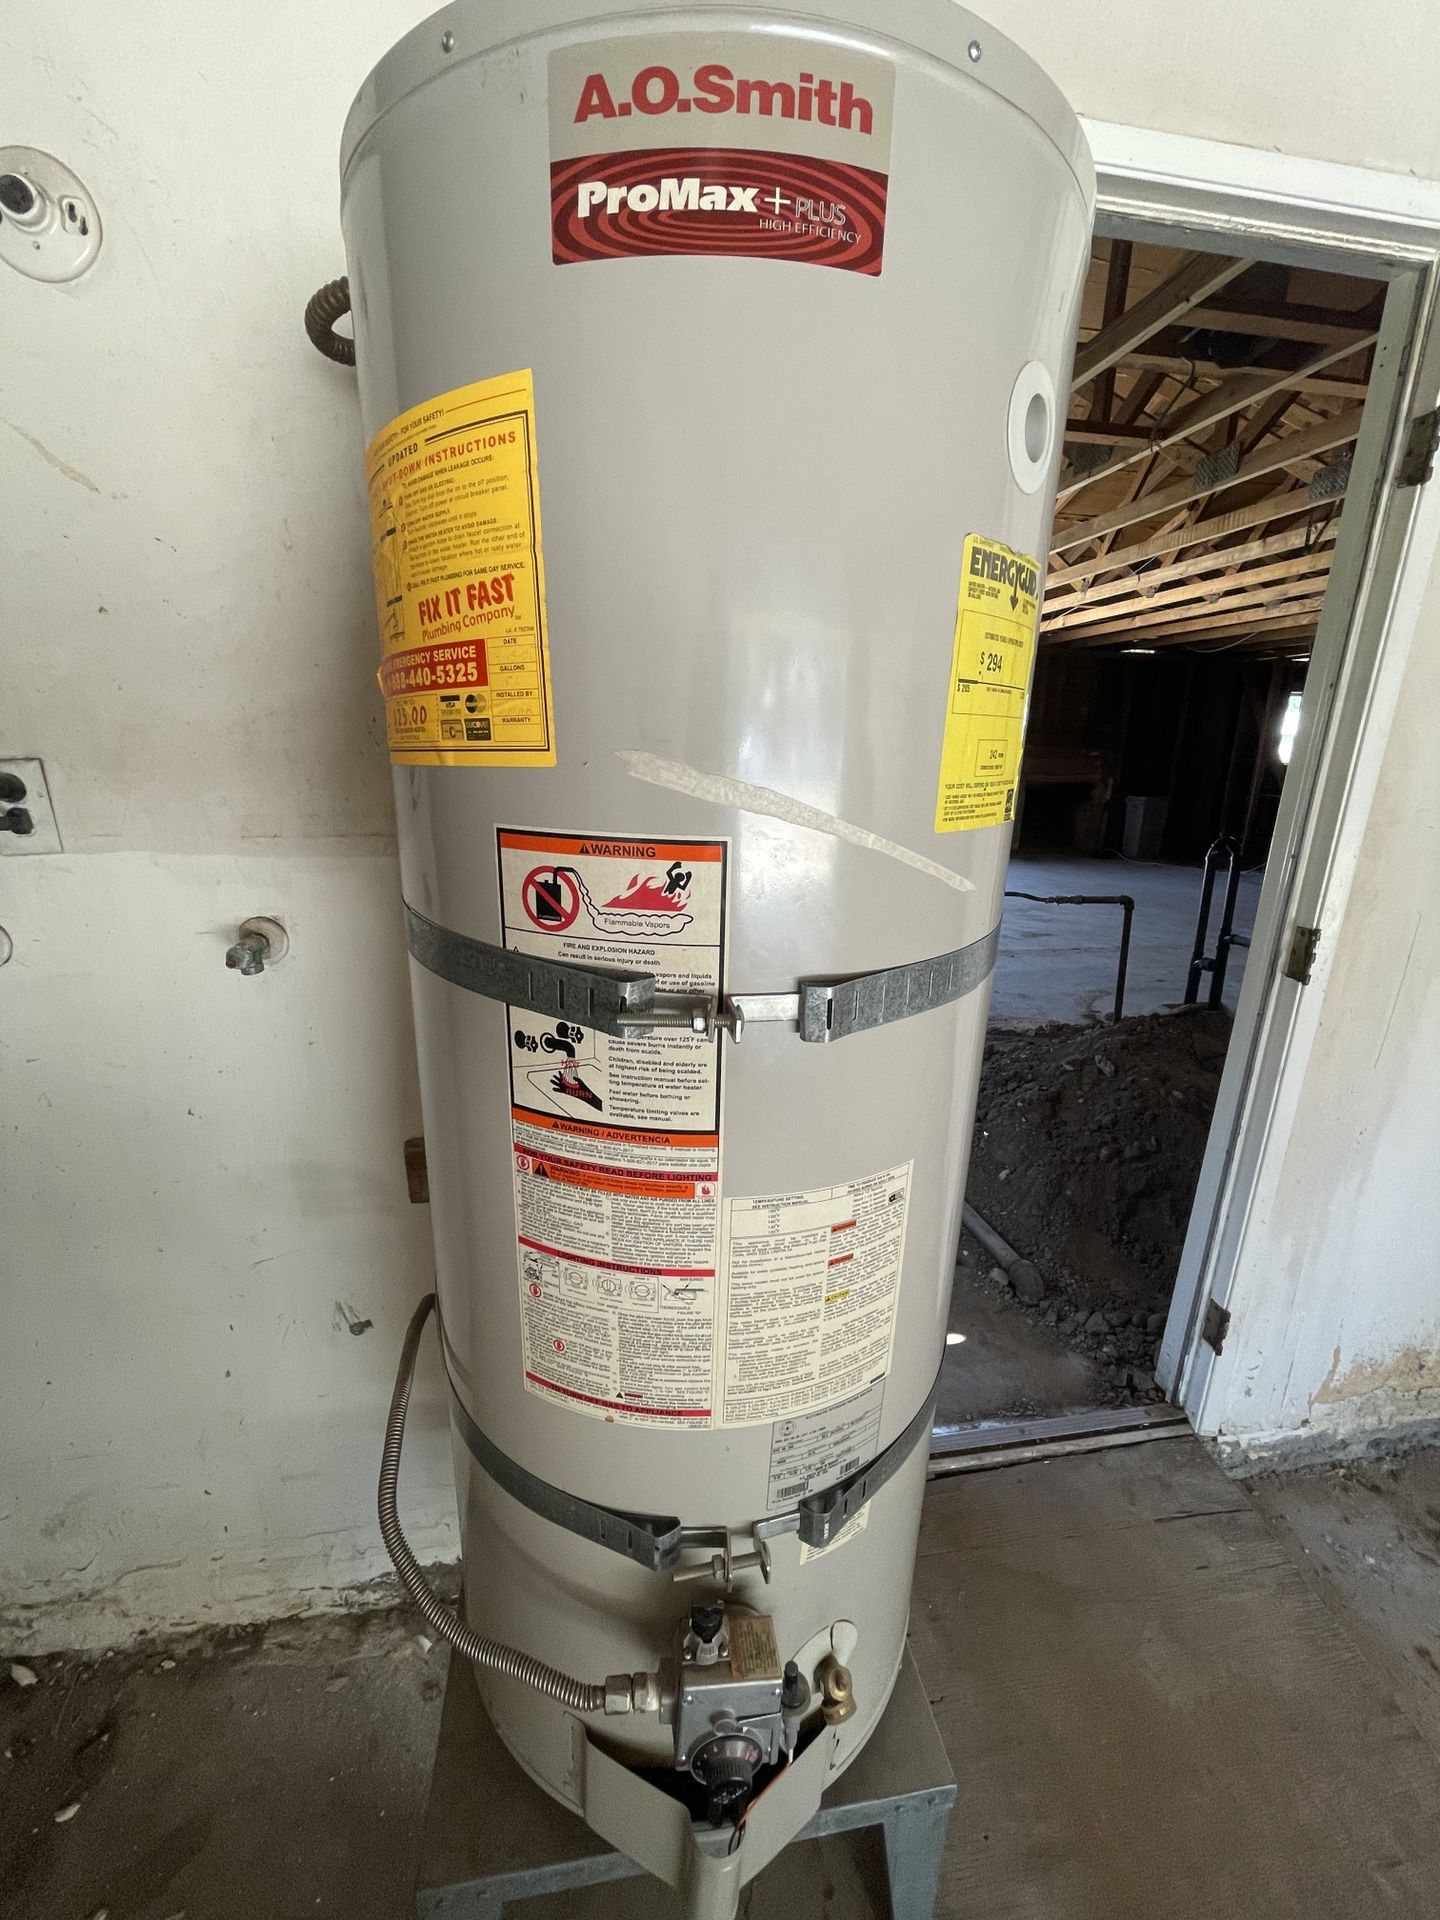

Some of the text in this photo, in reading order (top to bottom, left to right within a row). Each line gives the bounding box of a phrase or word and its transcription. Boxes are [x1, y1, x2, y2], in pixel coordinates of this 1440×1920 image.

[577, 178, 759, 218] ProMax
[795, 197, 846, 226] PLUS
[759, 219, 861, 245] HIGH EFFICIENCY
[388, 443, 418, 467] UPDATED
[425, 431, 516, 467] INSTRUCTIONS
[448, 460, 469, 472] LEAKAGE
[483, 524, 513, 535] connection
[491, 534, 505, 542] other
[463, 569, 473, 577] FOR
[473, 566, 488, 575] SAME
[489, 565, 499, 573] DAY
[418, 572, 515, 626] FIX IT FAST
[422, 605, 515, 642] Plumbing Company
[433, 645, 477, 662] SERVICE
[500, 664, 525, 672] GALLONS
[987, 652, 1003, 672] 294
[591, 844, 656, 858] WARNING
[604, 918, 643, 927] Flammable
[592, 945, 627, 954] EXPLOSION
[667, 1043, 693, 1051] instantly
[608, 1056, 635, 1064] Children,
[615, 1063, 637, 1071] highest
[620, 1073, 652, 1081] instruction
[621, 1080, 656, 1088] temperature
[565, 1088, 592, 1099] BURN
[609, 1104, 645, 1113] Temperature
[559, 1122, 599, 1136] WARNING
[606, 1131, 670, 1143] ADVERTENCIA
[523, 1148, 712, 1182] FOR YOUR SAFETY READ BEFORE LIGHTING
[557, 1251, 662, 1275] LIGHTING INSTRUCTIONS
[602, 1400, 617, 1409] GAS
[622, 1404, 632, 1412] TO
[634, 1406, 683, 1416] APPLIANCE
